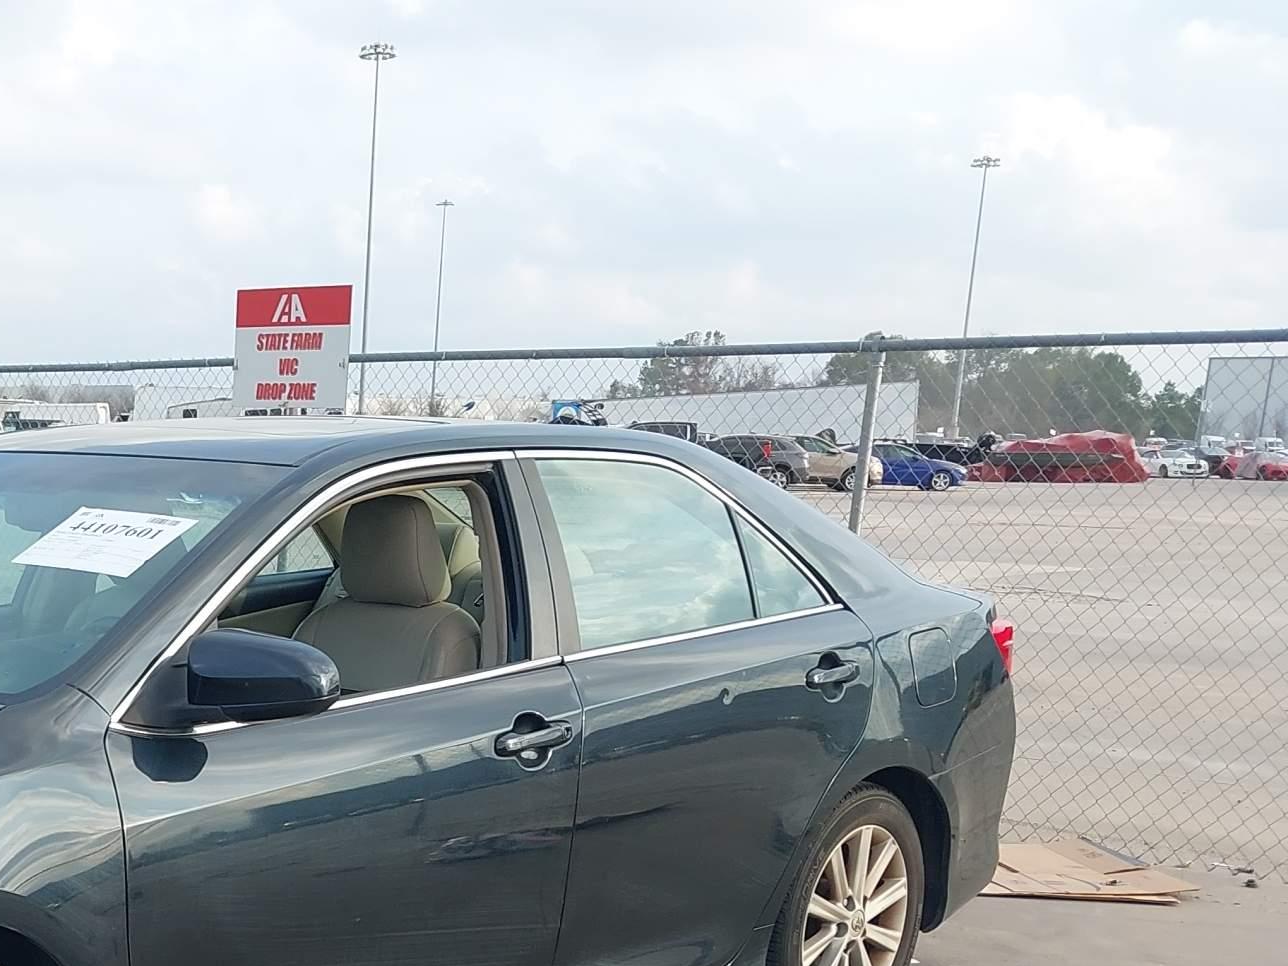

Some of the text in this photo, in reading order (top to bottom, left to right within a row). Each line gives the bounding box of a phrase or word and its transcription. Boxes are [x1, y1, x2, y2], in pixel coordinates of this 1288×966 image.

[256, 332, 323, 351] STATE FARM
[278, 358, 299, 376] VIC
[255, 383, 317, 400] DROP ZONE
[69, 520, 164, 540] 44107601
